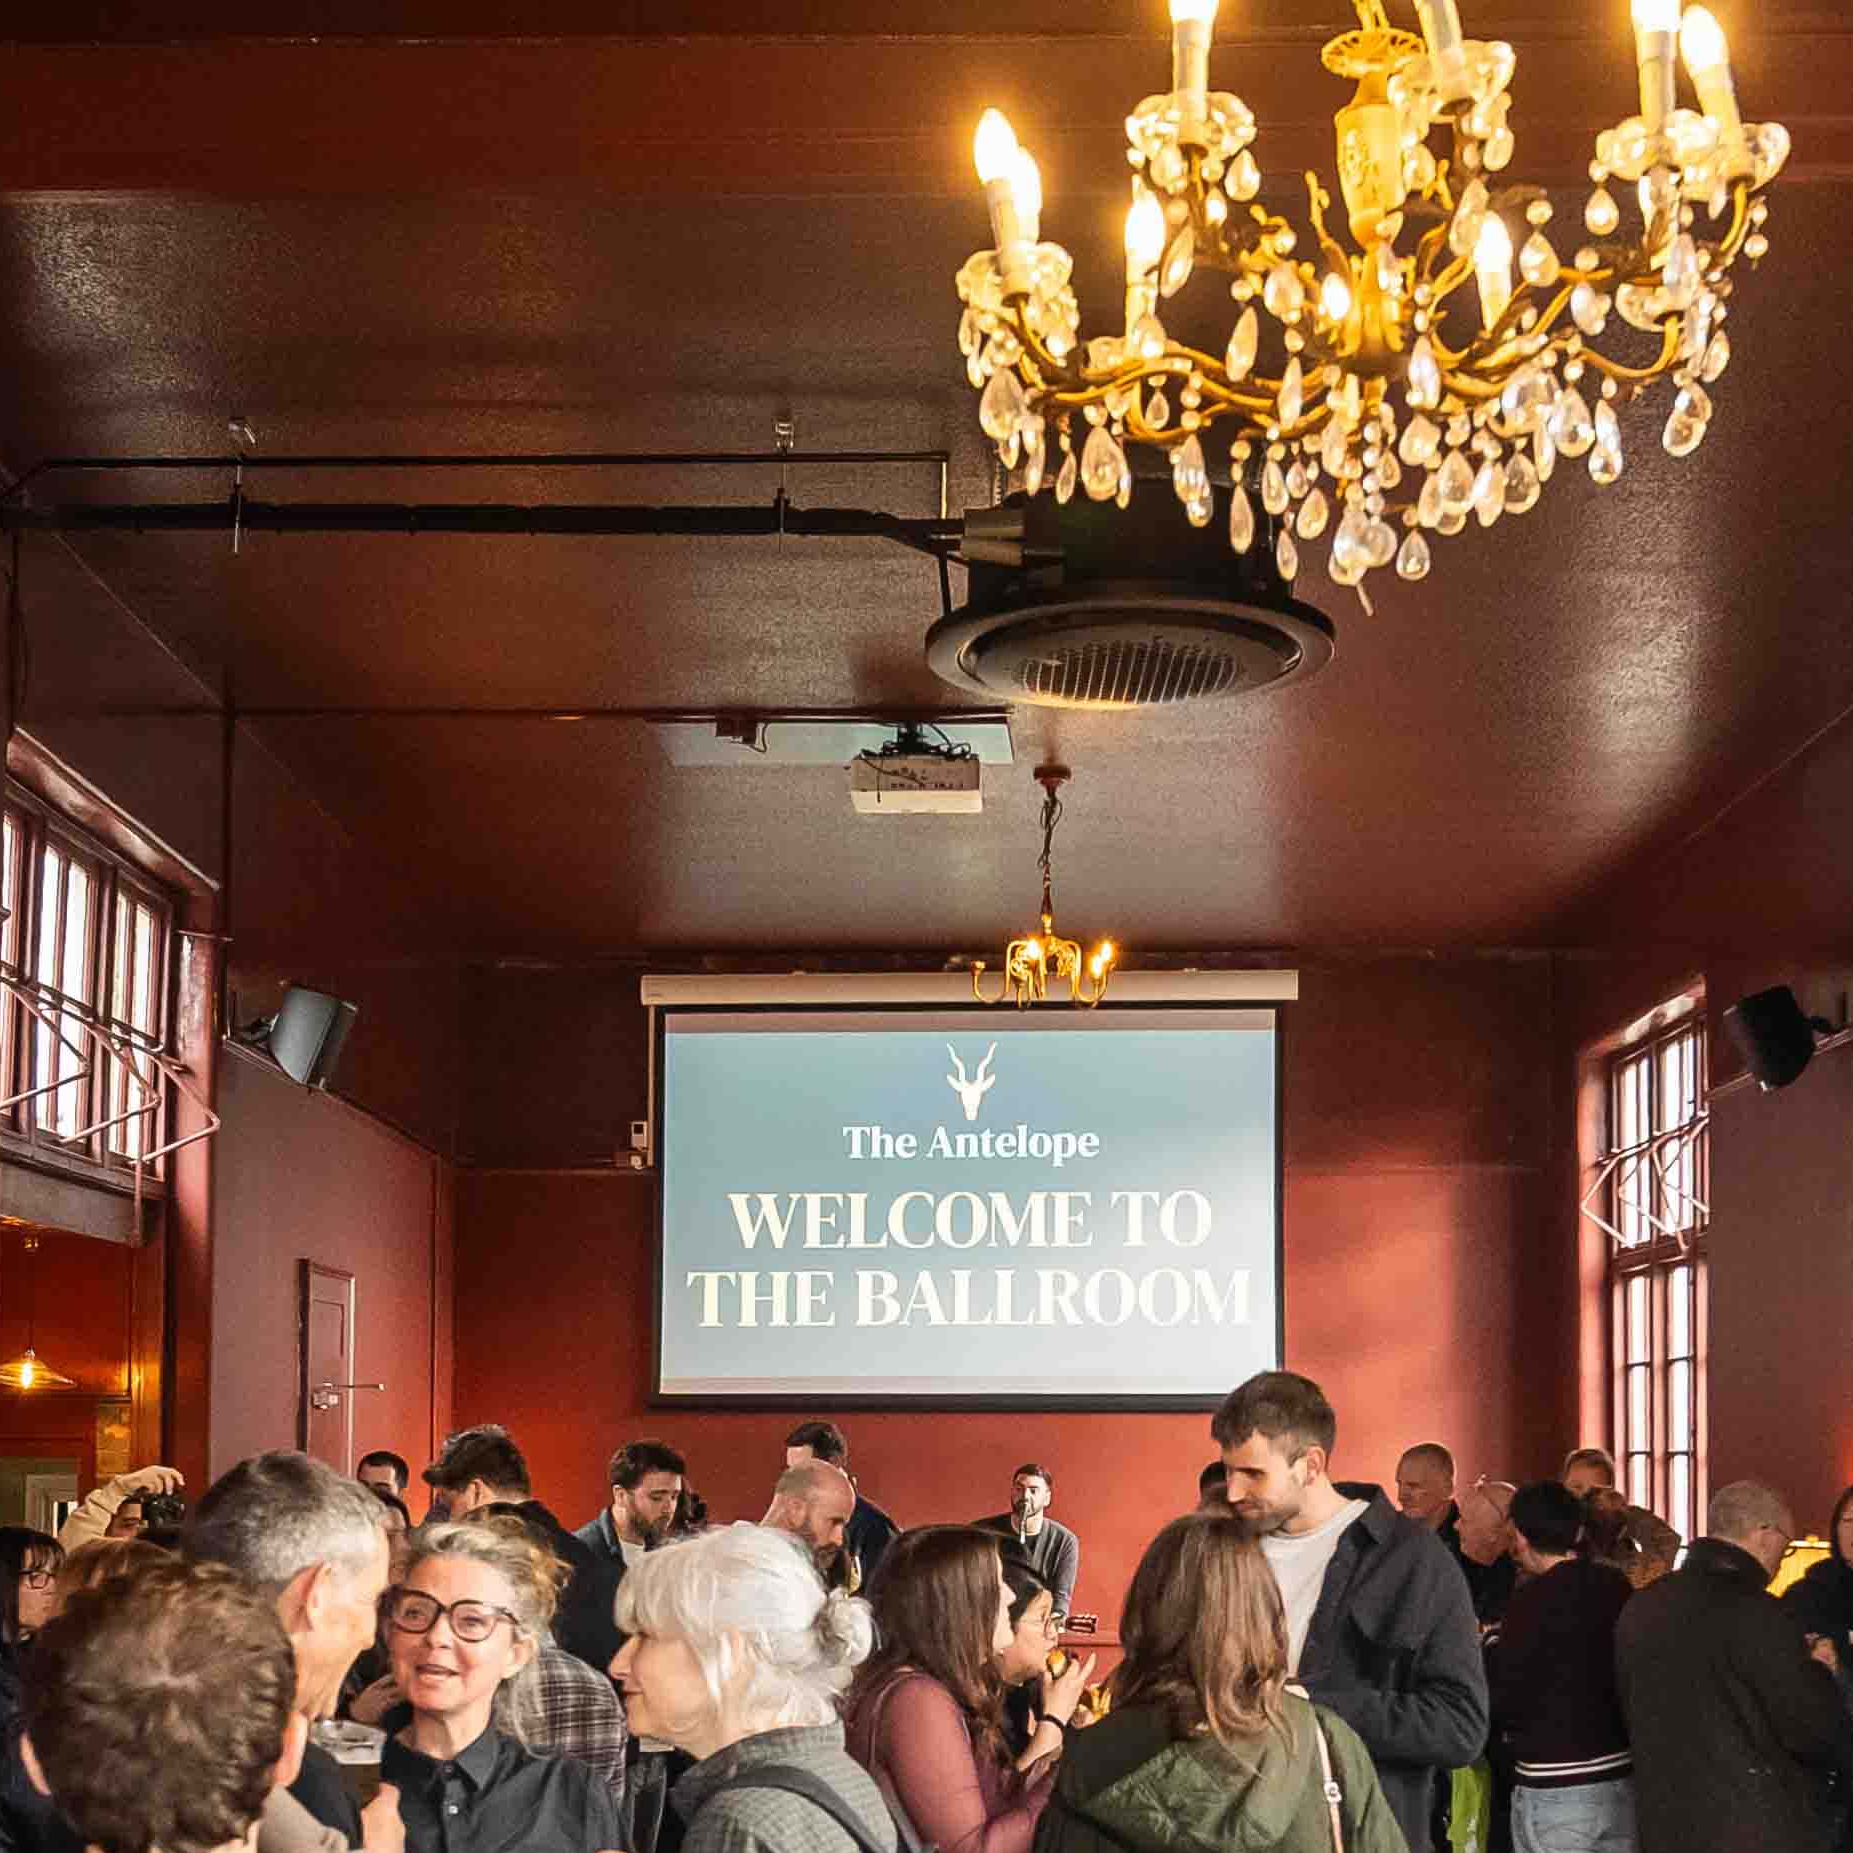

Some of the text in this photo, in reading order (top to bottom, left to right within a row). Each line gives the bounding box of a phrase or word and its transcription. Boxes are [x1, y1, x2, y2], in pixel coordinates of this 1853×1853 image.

[843, 1125, 1100, 1168] The Antelope
[728, 1189, 1213, 1249] WELCOME TO
[687, 1266, 1251, 1328] THE BALLROOM
